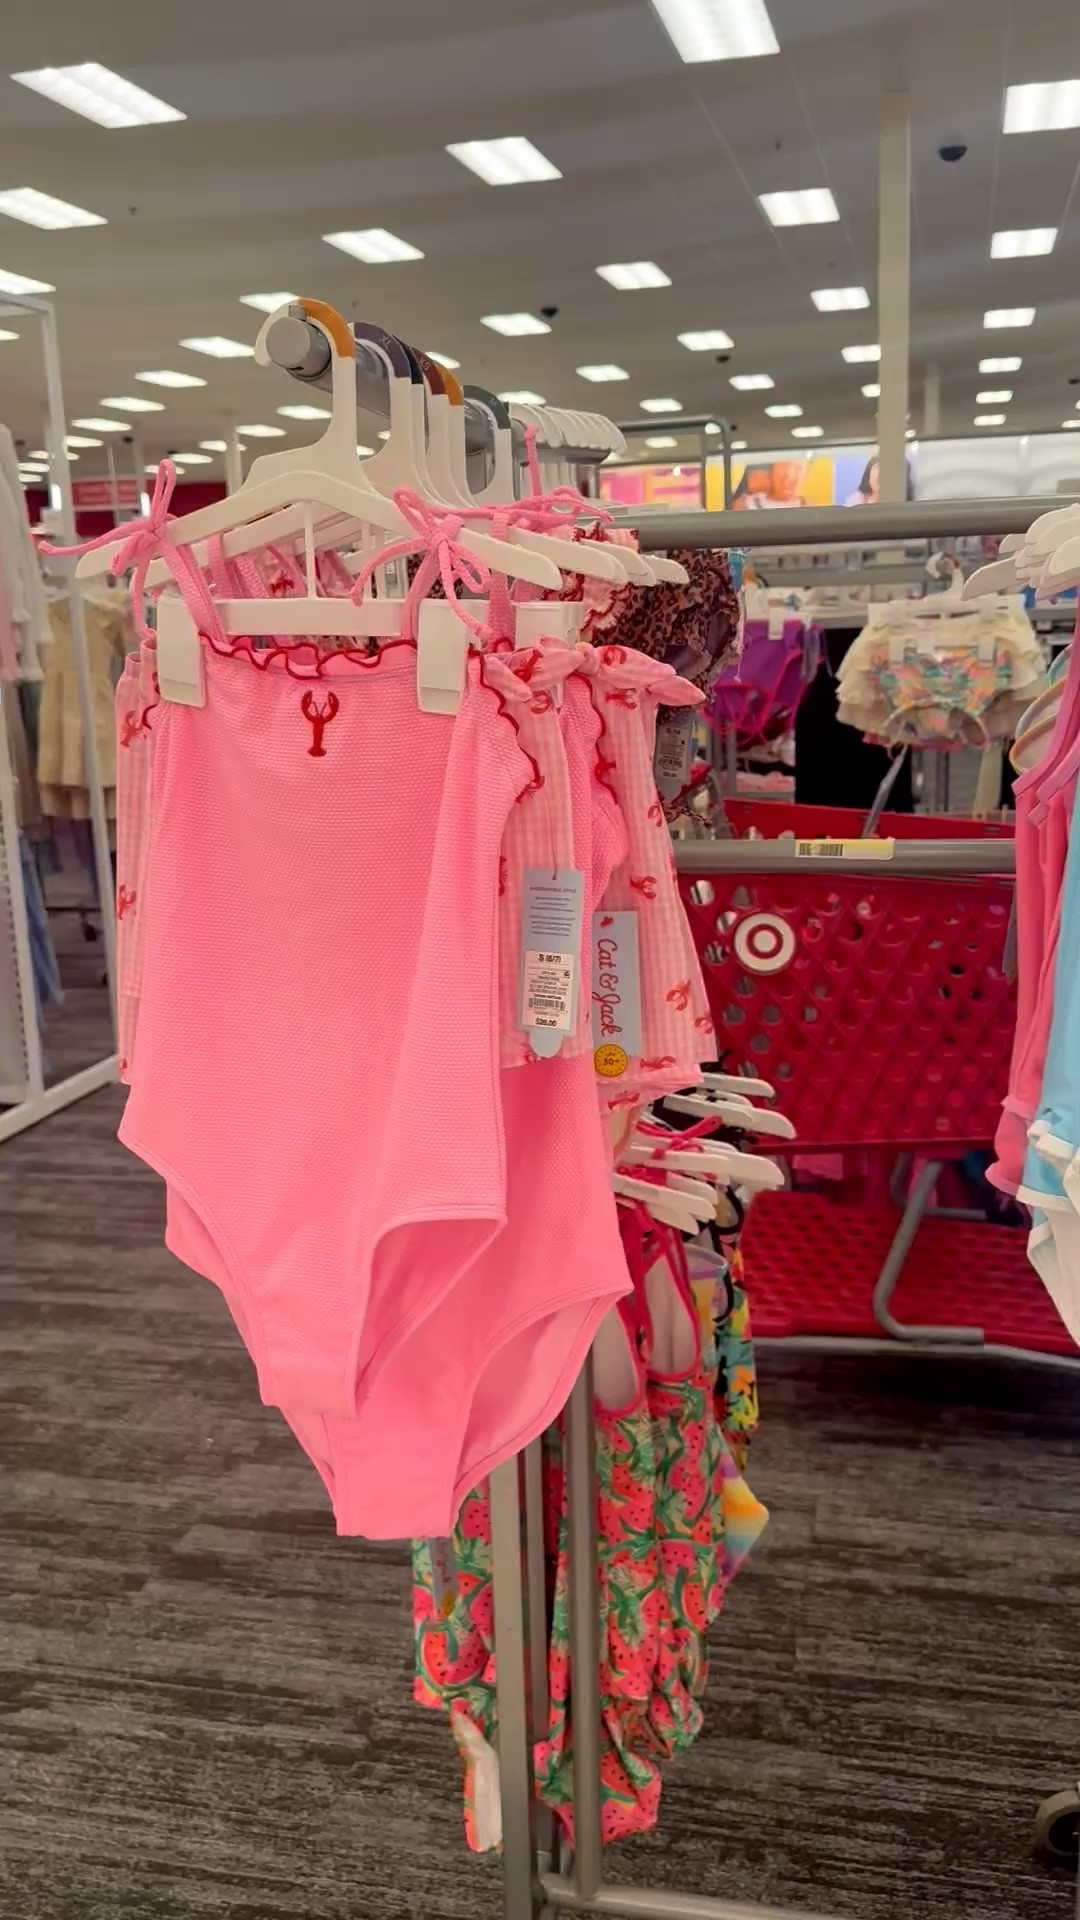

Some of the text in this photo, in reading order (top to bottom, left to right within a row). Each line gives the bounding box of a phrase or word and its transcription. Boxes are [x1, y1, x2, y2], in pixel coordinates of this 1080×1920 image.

[597, 938, 618, 970] Cat
[599, 973, 619, 991] &
[592, 991, 623, 1038] Jack
